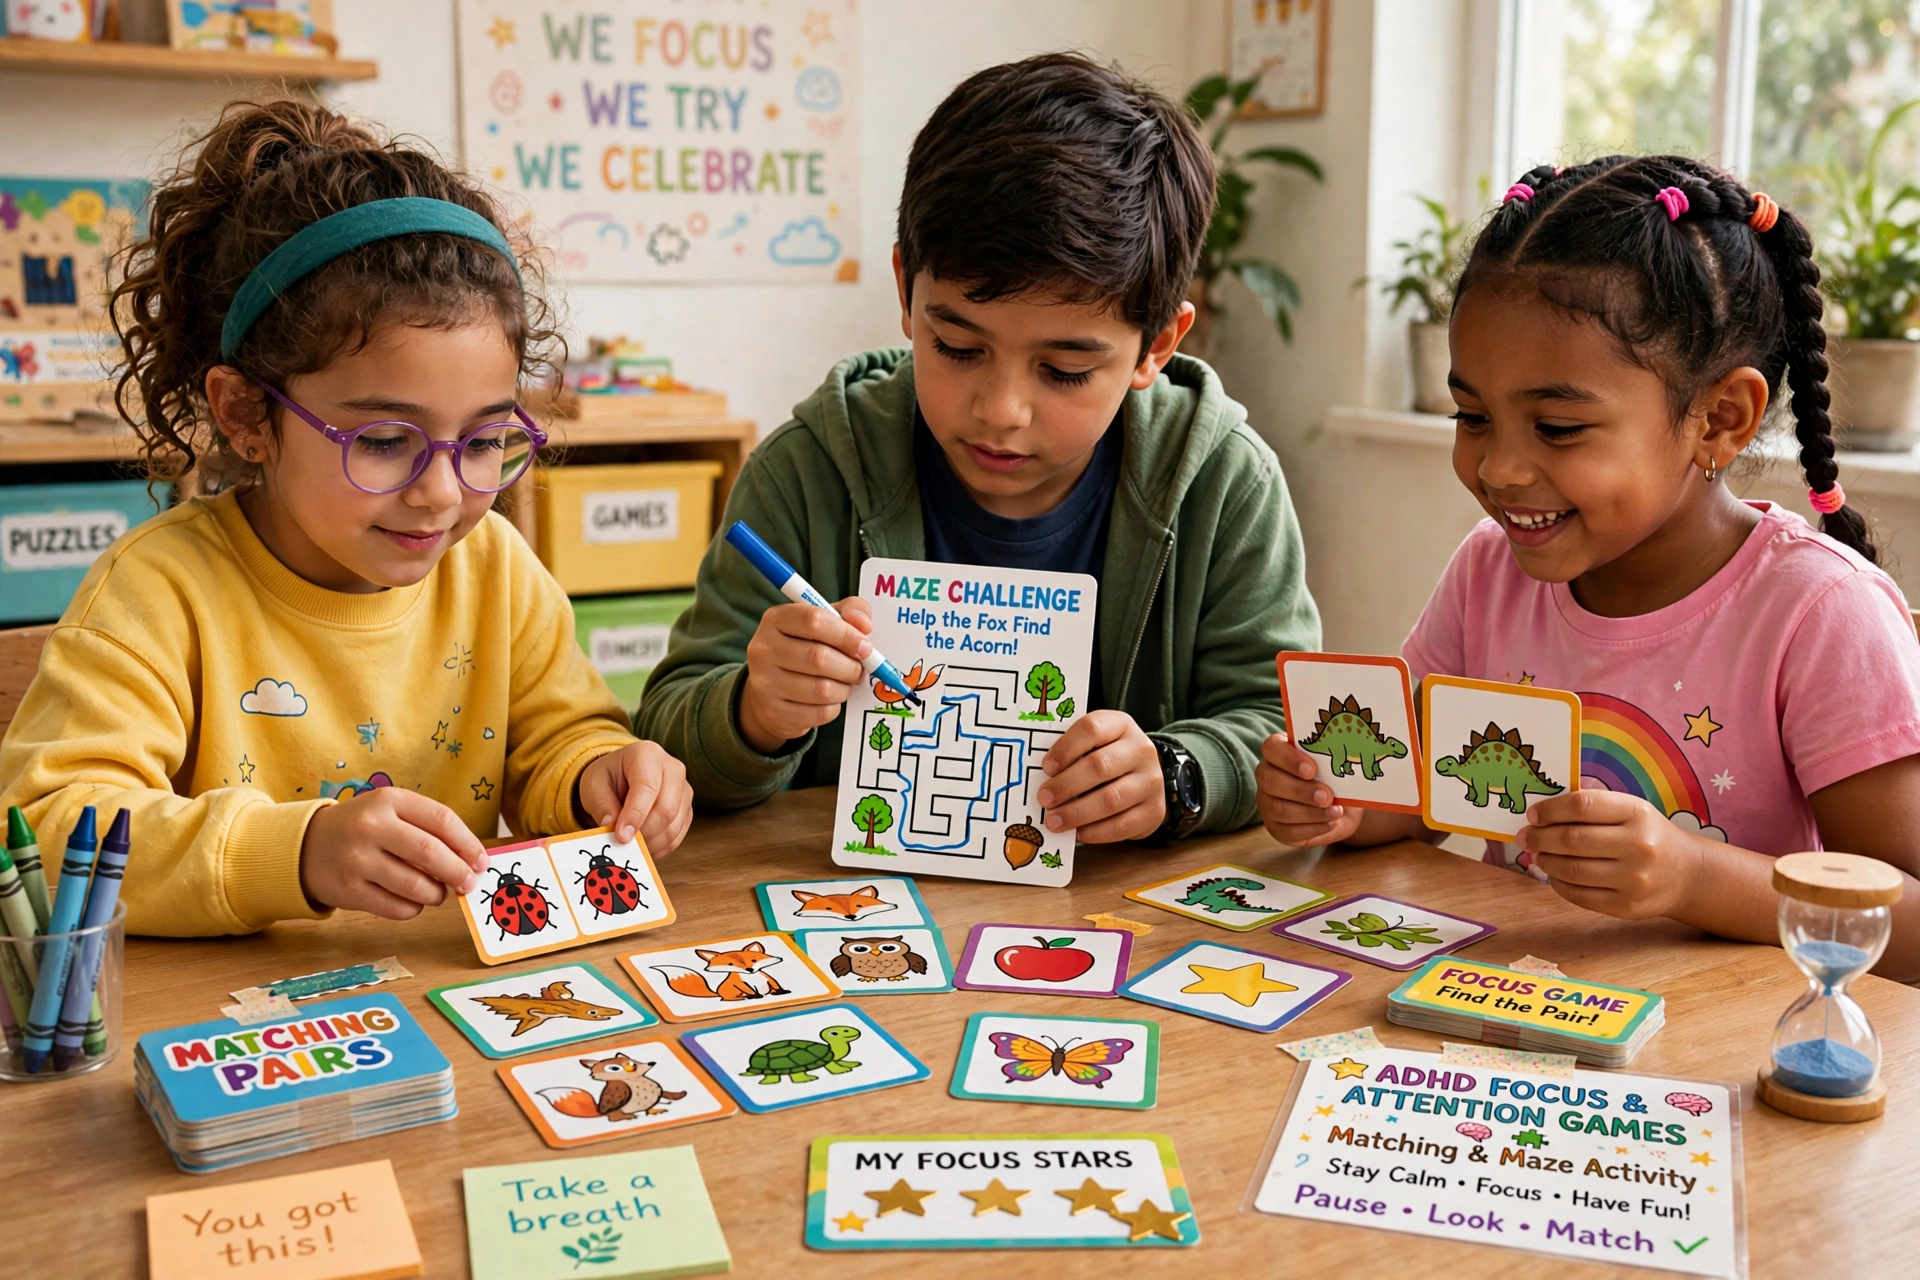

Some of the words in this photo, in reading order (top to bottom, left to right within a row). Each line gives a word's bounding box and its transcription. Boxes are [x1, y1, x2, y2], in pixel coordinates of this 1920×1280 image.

[542, 13, 613, 63] WE
[634, 18, 774, 71] FOCUS
[583, 82, 649, 128] WE
[667, 85, 747, 131] TRY
[515, 143, 581, 190] WE
[601, 146, 826, 194] CELEBRATE
[592, 502, 668, 530] GAMES
[10, 524, 117, 555] PUZZLES
[874, 574, 941, 601] MAZE
[948, 580, 1081, 612] CHALLENGE
[897, 606, 937, 630] Help
[942, 611, 971, 629] the
[977, 613, 1007, 632] Fox
[1013, 616, 1051, 635] Find
[925, 632, 955, 650] the
[960, 635, 1019, 655] Acorn!
[1435, 985, 1490, 1005] Find
[1494, 996, 1533, 1014] the
[1540, 1005, 1600, 1027] Pair!
[1439, 967, 1537, 995] FOCUS
[1543, 987, 1629, 1014] GAME
[171, 1010, 396, 1068] MATCHING
[220, 1039, 387, 1091] PAIRS
[1375, 1064, 1477, 1093] ADHD
[1489, 1077, 1609, 1110] FOCUS
[1622, 1093, 1649, 1114] &
[1341, 1085, 1545, 1128] ATTENTION
[1558, 1110, 1687, 1146] GAMES
[855, 1152, 904, 1170] MY
[917, 1151, 1021, 1170] FOCUS
[1034, 1150, 1134, 1169] STARS
[1327, 1125, 1458, 1165] Matching
[1467, 1144, 1489, 1164] &
[1499, 1147, 1574, 1174] Maze
[1583, 1158, 1697, 1195] Activity
[502, 1176, 608, 1202] Take
[630, 1174, 656, 1189] a
[1326, 1157, 1380, 1184] Stay
[1389, 1166, 1447, 1189] Calm
[1476, 1176, 1542, 1201] Focus
[1572, 1189, 1630, 1213] Have
[1641, 1198, 1691, 1221] Fun!
[182, 1208, 265, 1237] You
[288, 1191, 358, 1230] got
[508, 1197, 661, 1234] breath
[1294, 1184, 1387, 1216] Pause
[1428, 1203, 1504, 1233] Look
[1545, 1219, 1655, 1254] Match
[217, 1225, 335, 1267] this!
